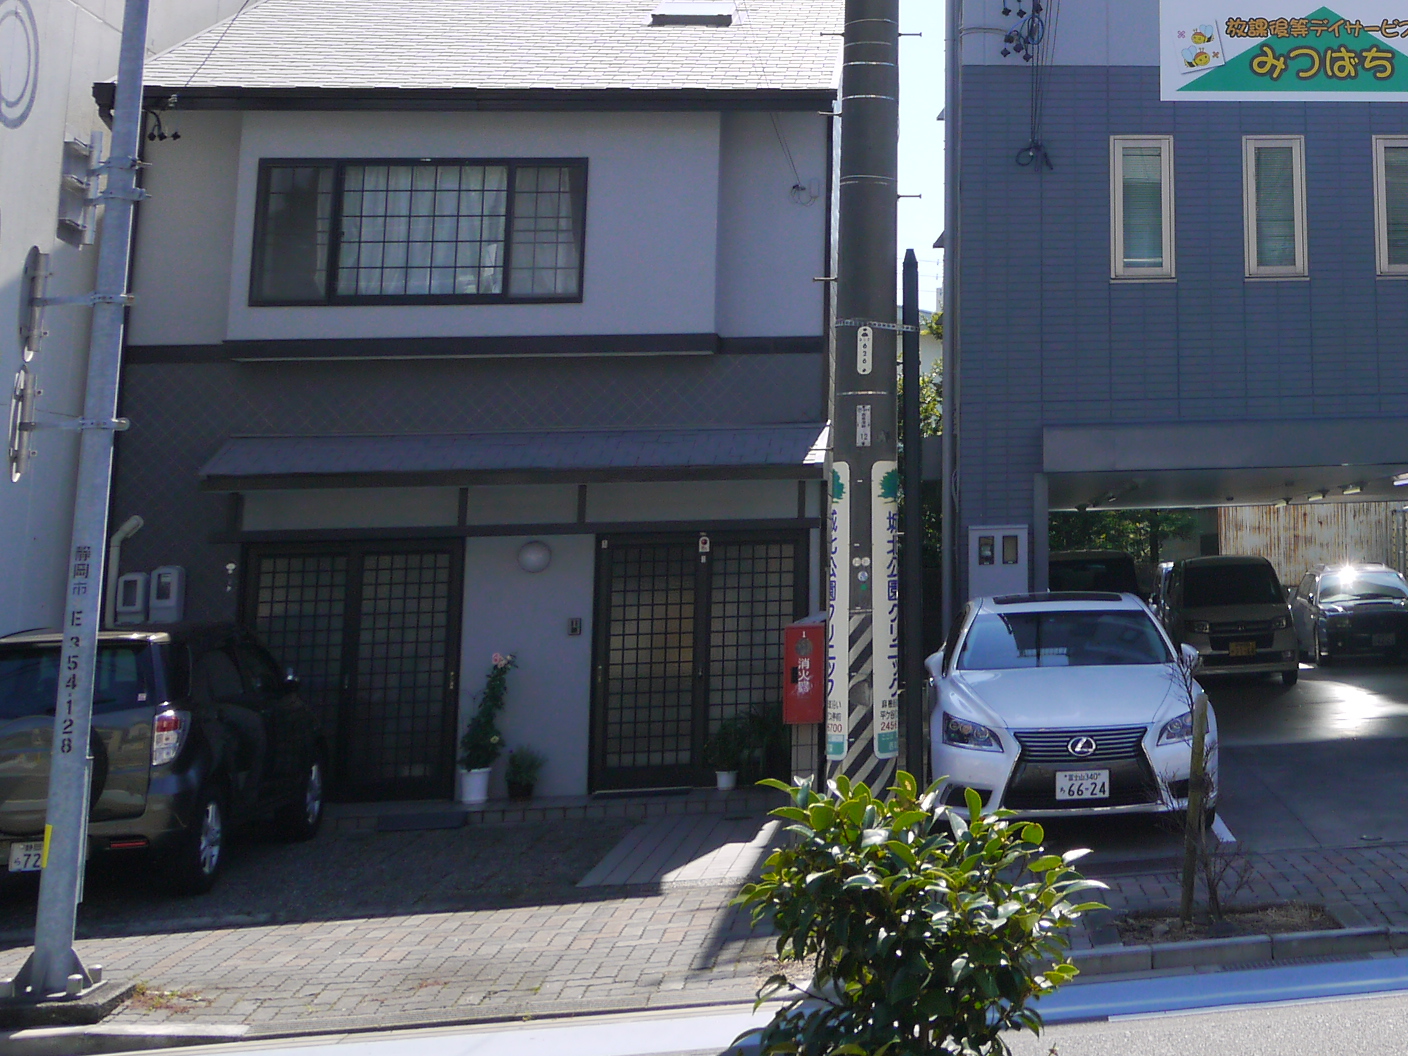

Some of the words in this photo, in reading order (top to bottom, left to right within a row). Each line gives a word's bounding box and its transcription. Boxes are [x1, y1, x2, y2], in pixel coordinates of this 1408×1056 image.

[1249, 43, 1395, 81] みつばち
[73, 546, 91, 596] 静岡市
[1067, 781, 1106, 797] 66-24
